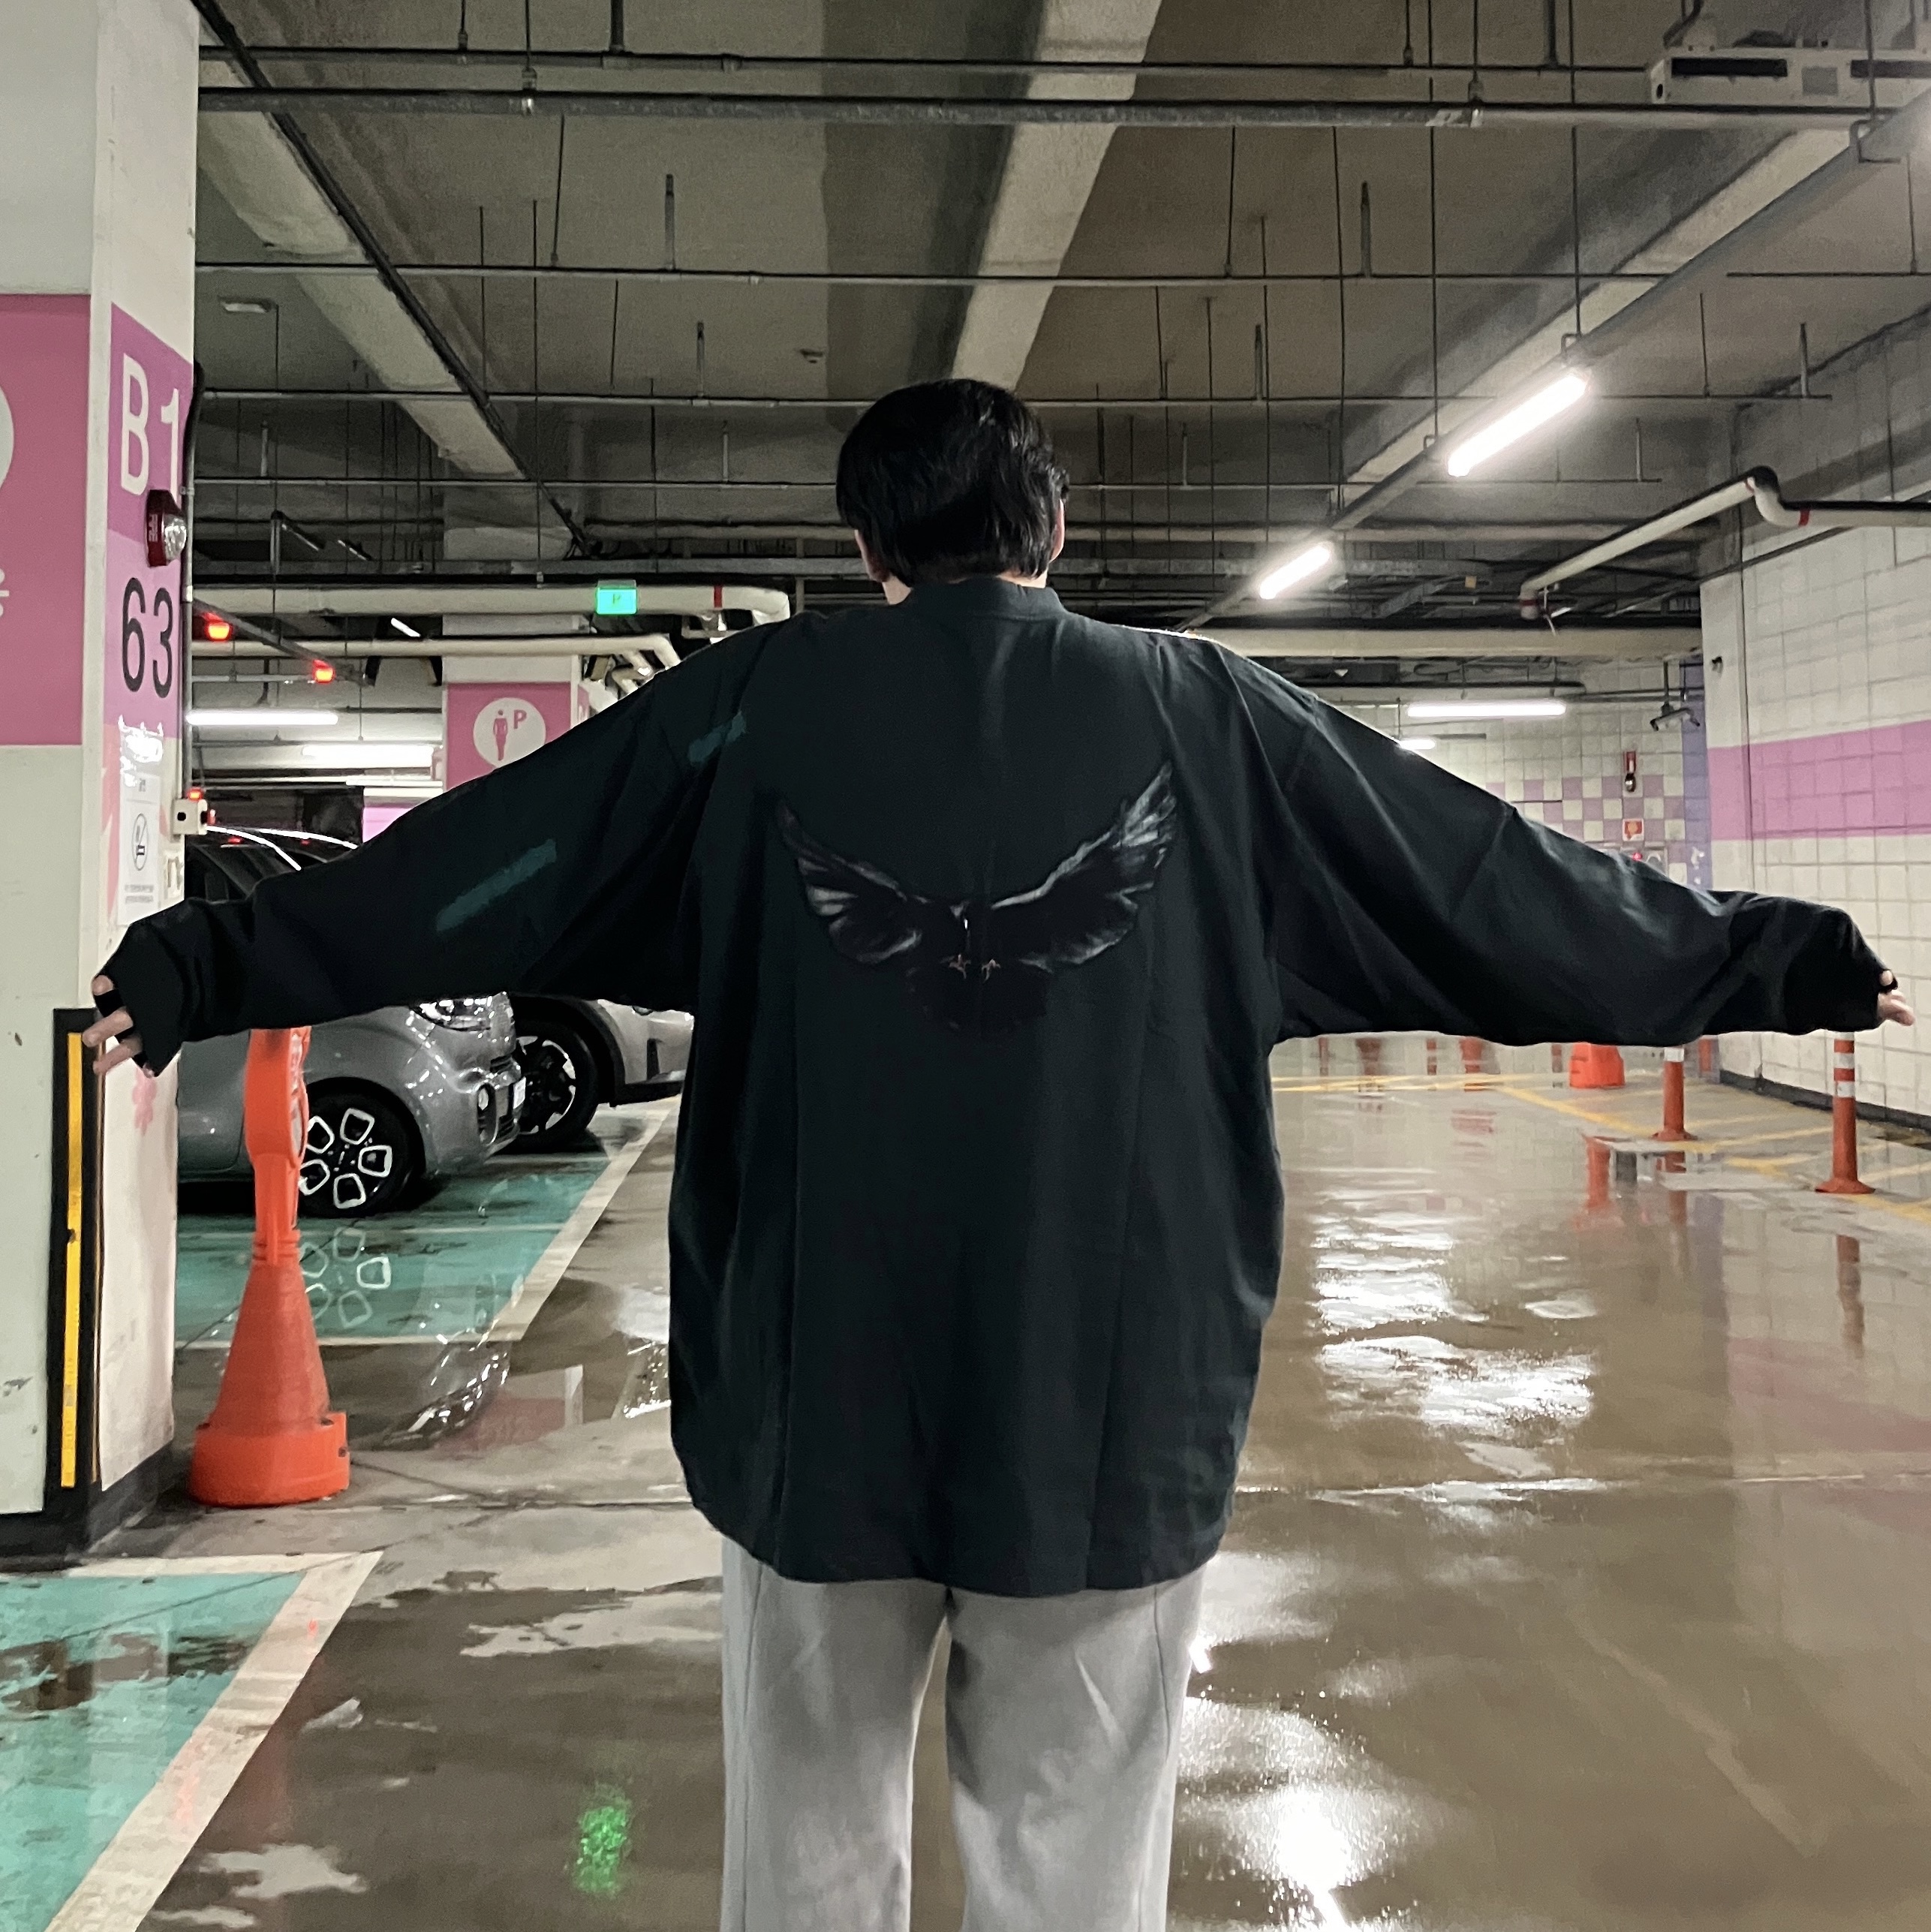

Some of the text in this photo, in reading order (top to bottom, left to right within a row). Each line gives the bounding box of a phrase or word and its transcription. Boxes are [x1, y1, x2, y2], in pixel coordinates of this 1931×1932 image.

[121, 352, 179, 502] B1
[148, 513, 158, 543] FIRE
[122, 577, 173, 698] 63
[513, 709, 527, 730] P
